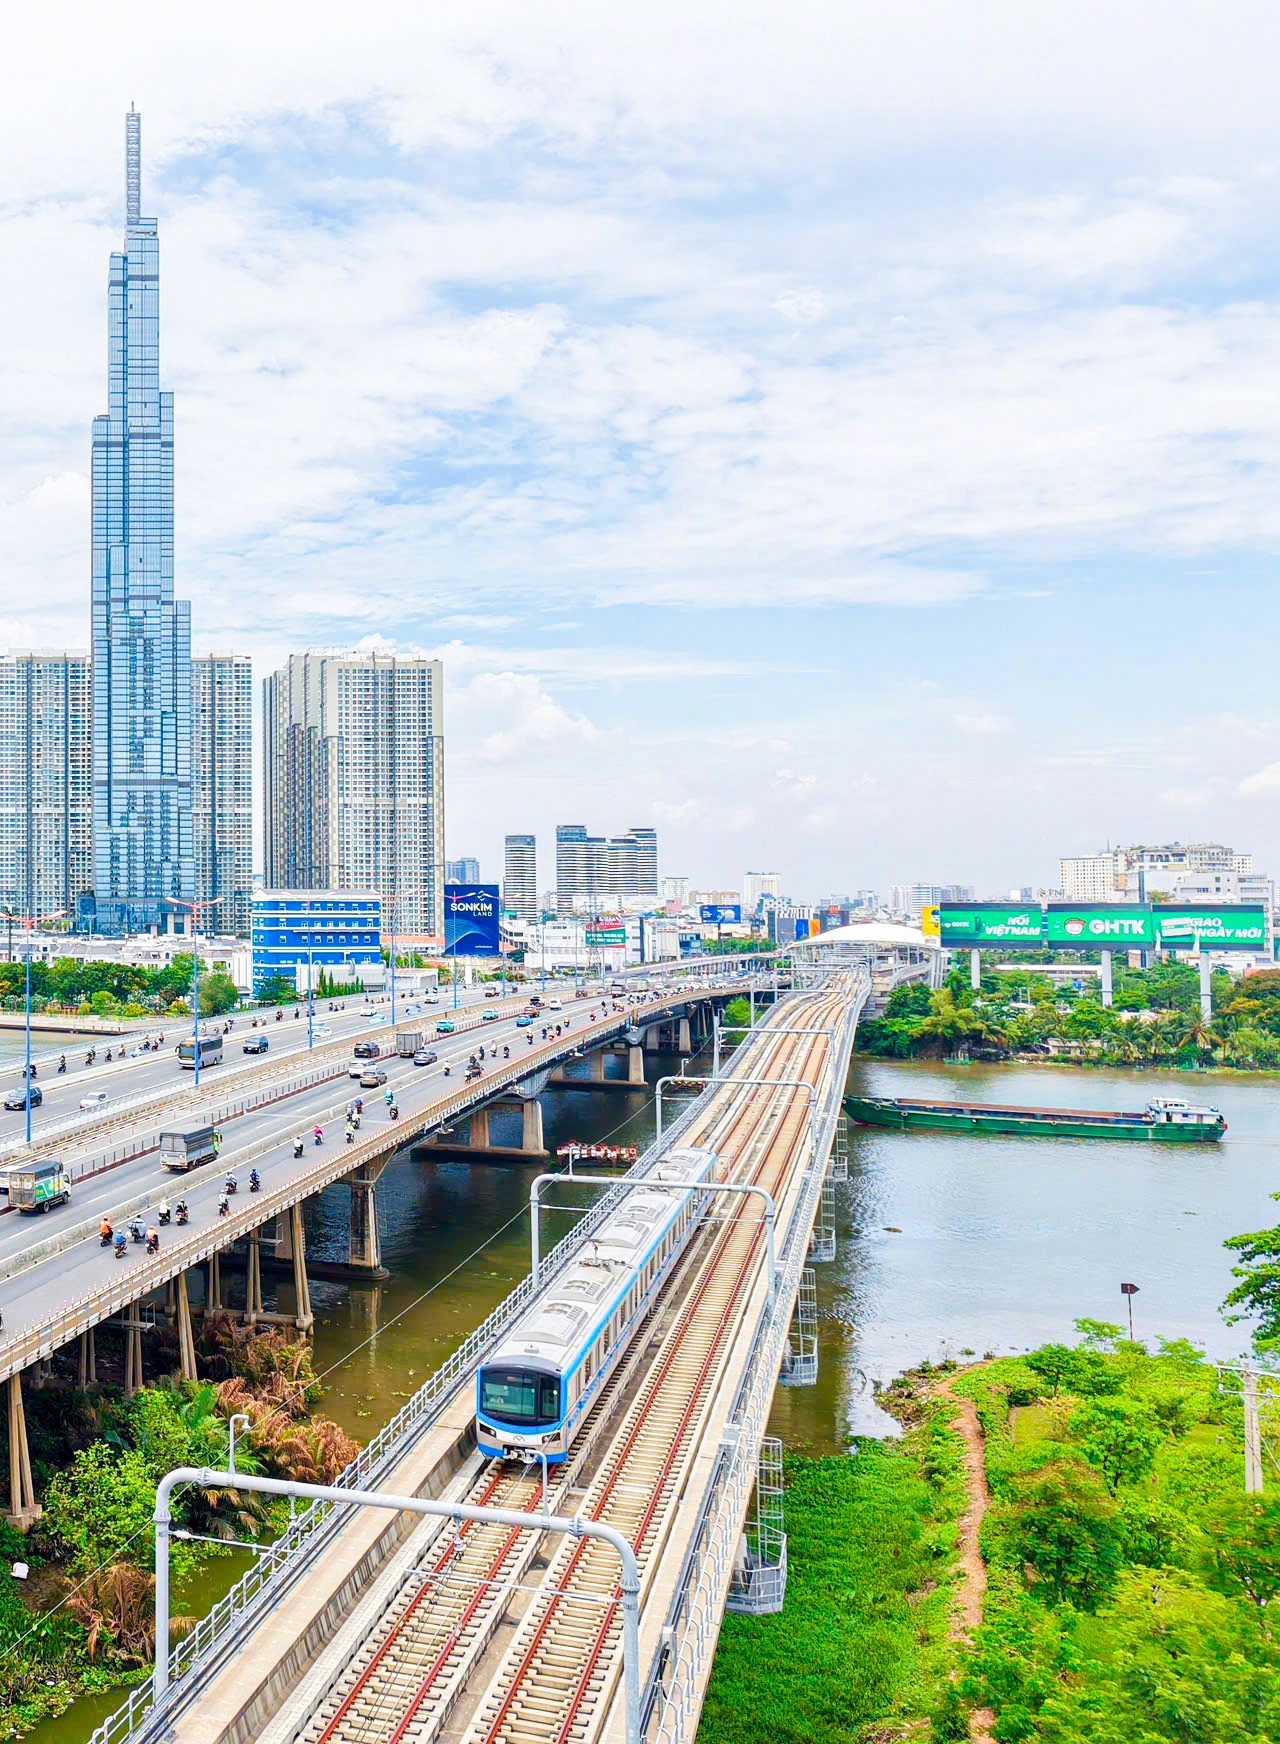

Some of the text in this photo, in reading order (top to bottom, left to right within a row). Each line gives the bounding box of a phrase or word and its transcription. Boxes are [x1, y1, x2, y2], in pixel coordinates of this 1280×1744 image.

[450, 903, 493, 911] SONKIM
[1007, 914, 1030, 925] NỐI
[1088, 919, 1145, 935] GHTK
[1197, 926, 1234, 938] NGÀY
